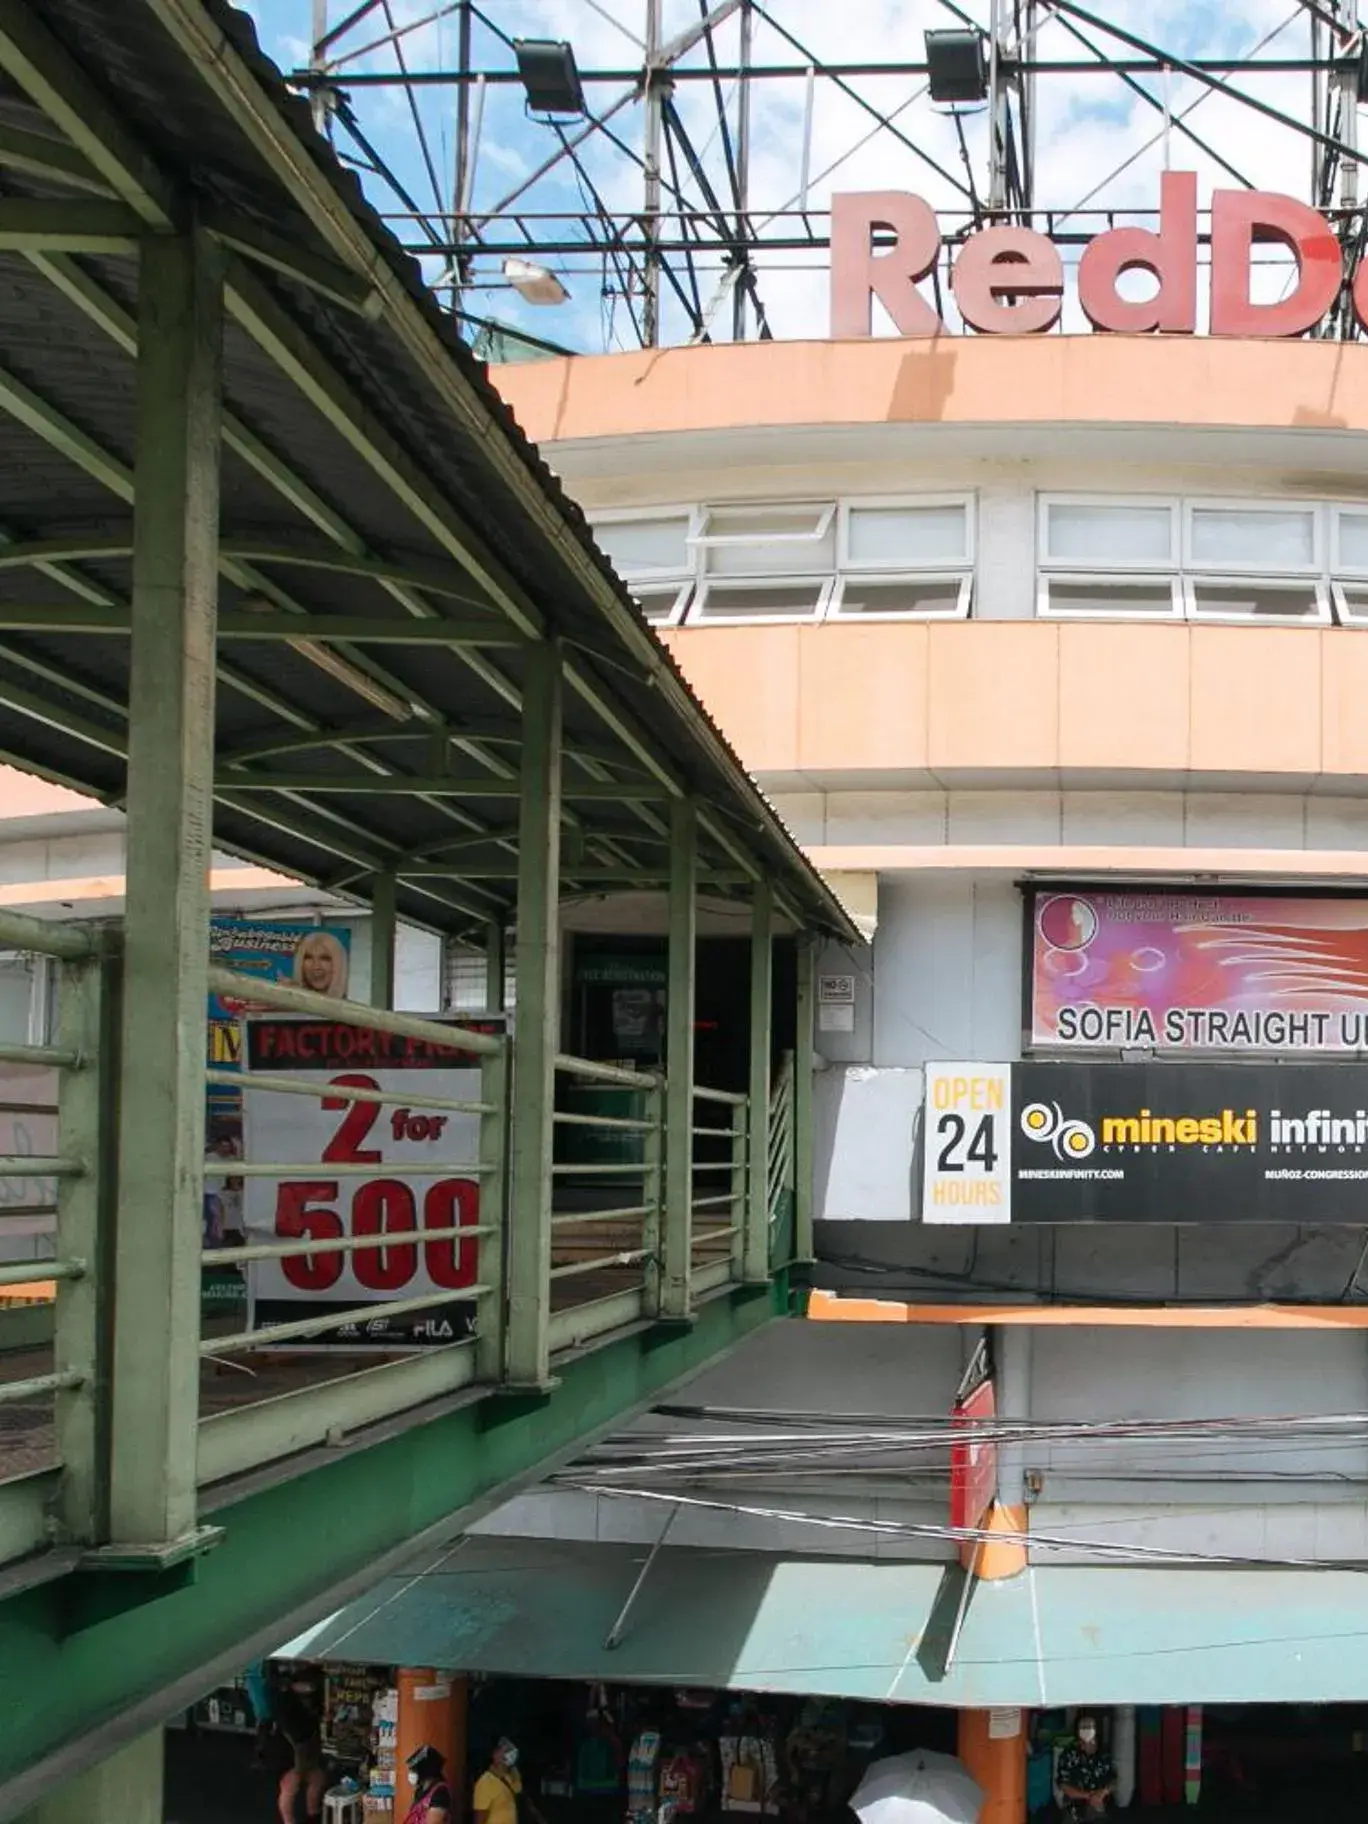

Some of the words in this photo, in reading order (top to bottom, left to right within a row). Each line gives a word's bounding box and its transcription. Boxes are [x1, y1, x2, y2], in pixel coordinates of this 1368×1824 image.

[259, 1022, 395, 1058] FACTORY
[1058, 1008, 1155, 1040] SOFIA
[1166, 1010, 1329, 1044] STRAIGHT
[933, 1078, 1004, 1111] OPEN
[321, 1073, 382, 1163] 2
[391, 1108, 448, 1141] for
[1103, 1110, 1257, 1144] mineski
[937, 1113, 999, 1172] 24
[932, 1181, 1003, 1206] HOURS
[275, 1178, 480, 1290] 500
